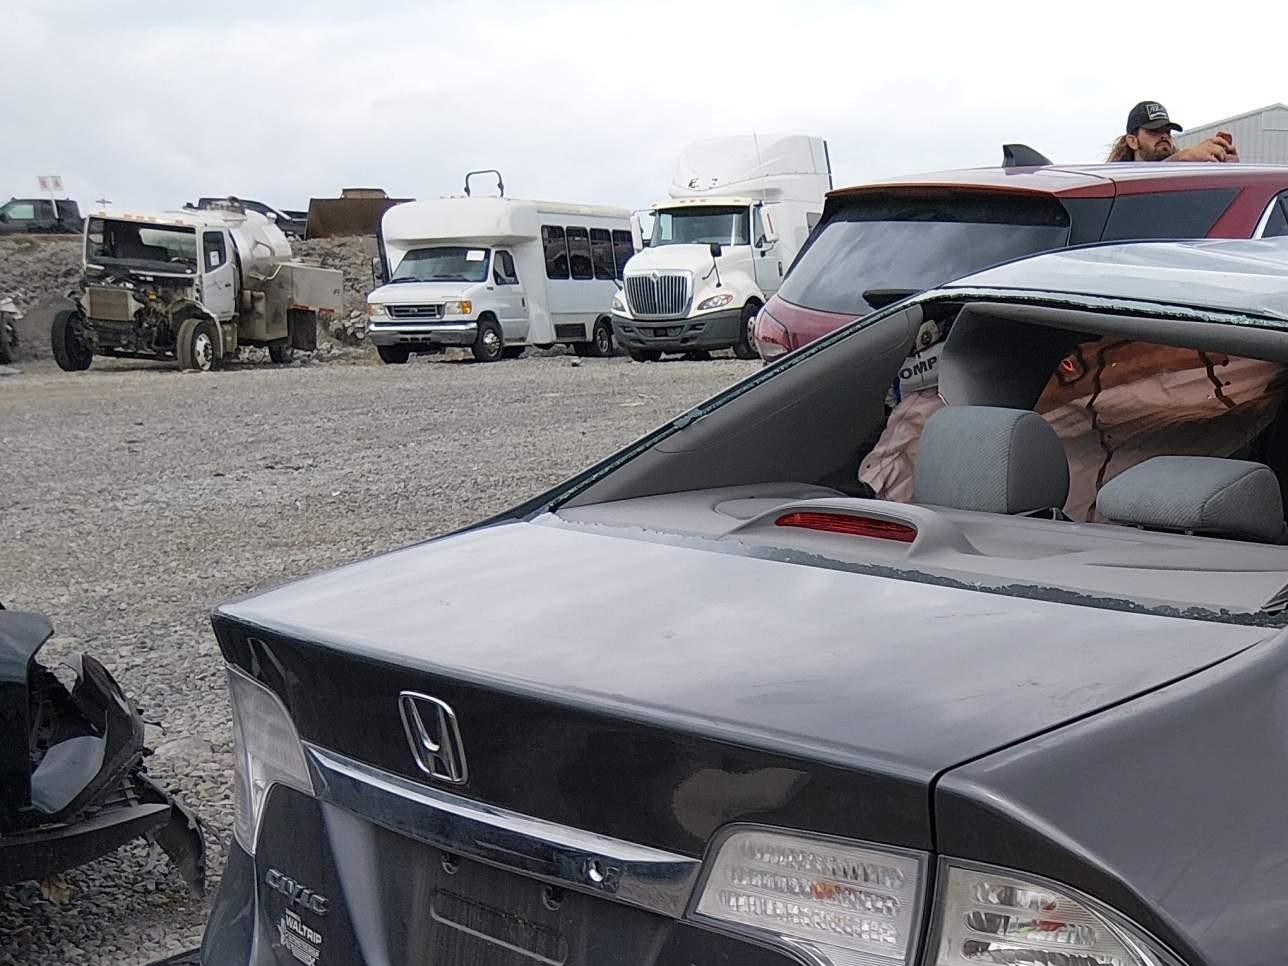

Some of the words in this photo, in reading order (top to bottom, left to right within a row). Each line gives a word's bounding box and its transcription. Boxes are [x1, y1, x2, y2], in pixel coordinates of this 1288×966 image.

[900, 356, 938, 380] OMP
[265, 868, 329, 915] CIVIC
[285, 912, 322, 944] WALTRIP
